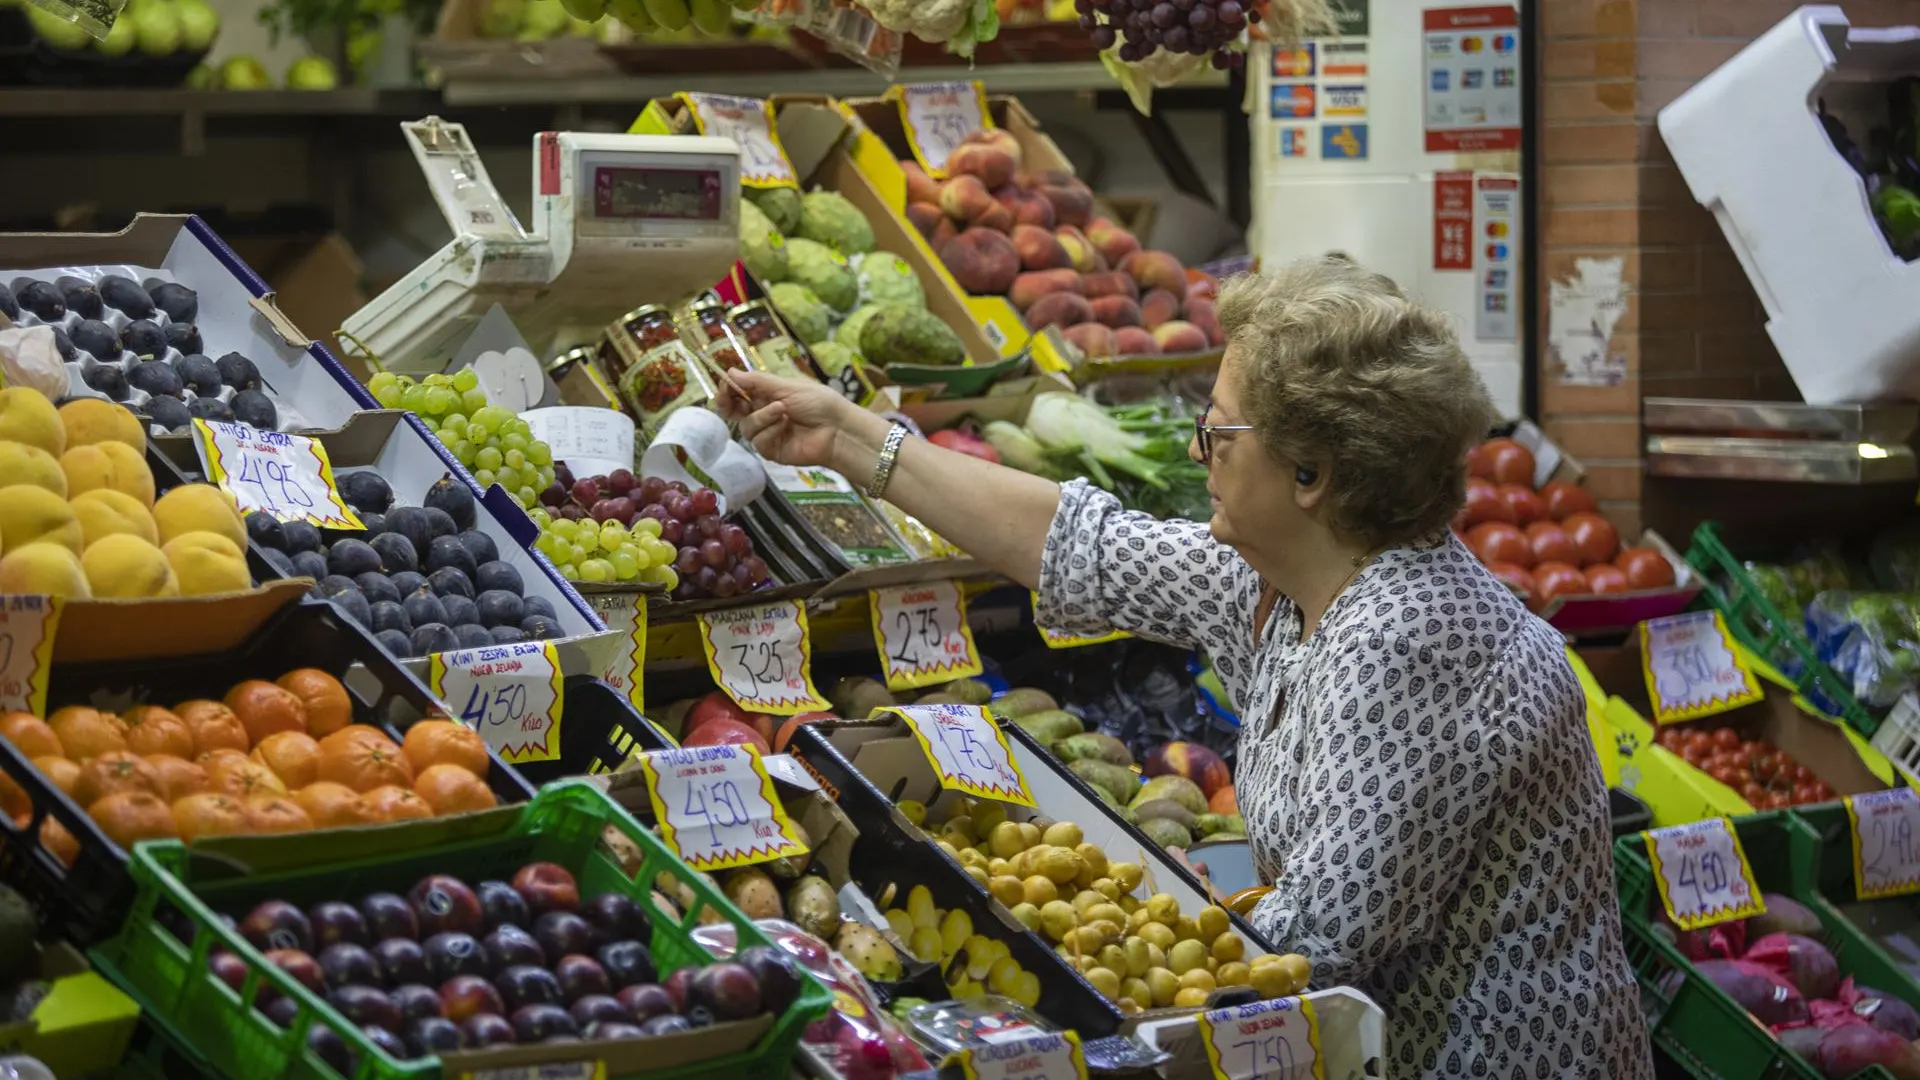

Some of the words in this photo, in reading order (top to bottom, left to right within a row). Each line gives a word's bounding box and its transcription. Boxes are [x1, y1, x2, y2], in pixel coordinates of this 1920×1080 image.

[218, 424, 252, 441] HIGO
[258, 431, 295, 448] EXTRA
[240, 453, 314, 512] 4'95
[711, 608, 757, 624] MANZANA
[763, 607, 789, 620] EXTRA
[514, 643, 541, 656] EXTRA
[661, 749, 694, 767] HIGO
[696, 746, 737, 762] CHUMBO
[684, 780, 750, 848] 4'50
